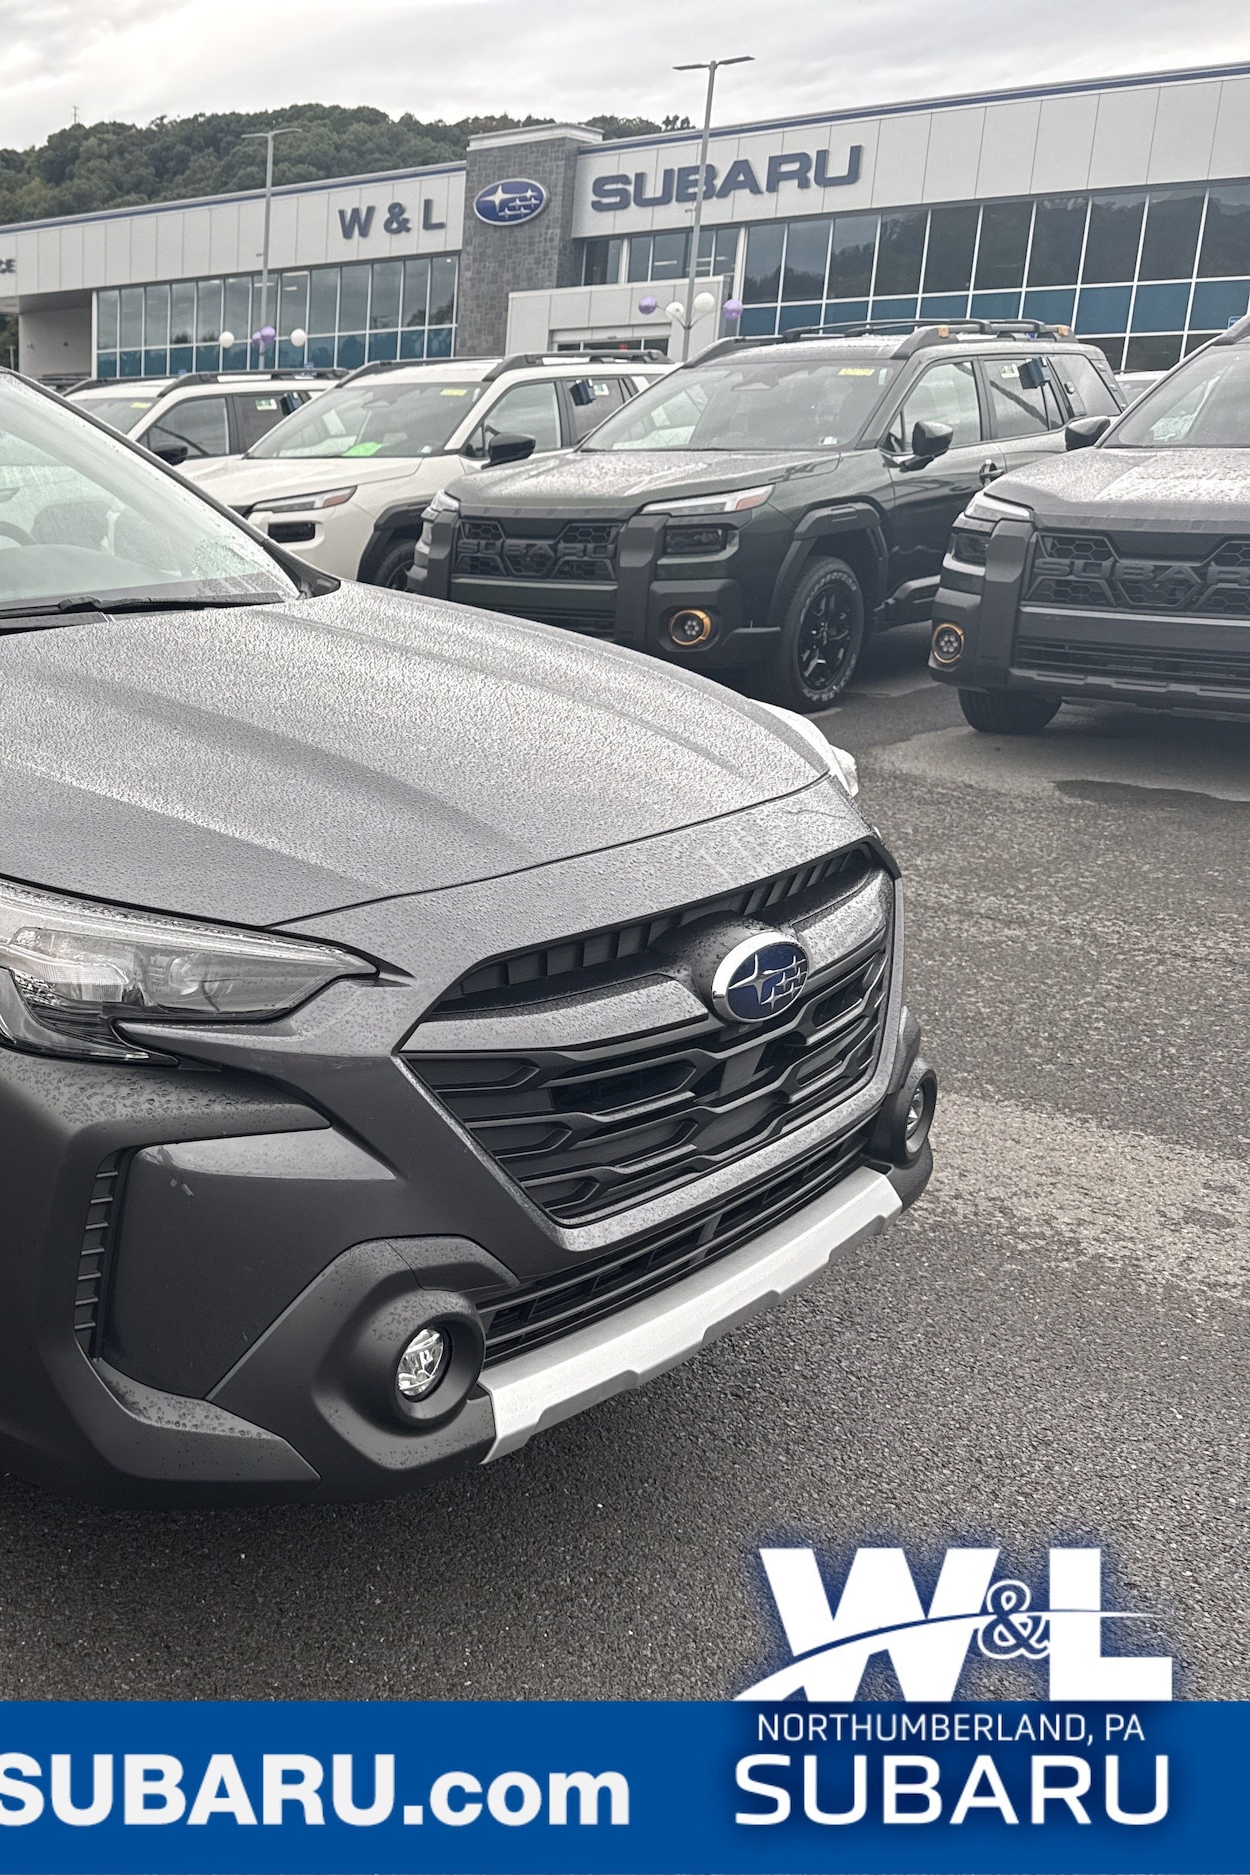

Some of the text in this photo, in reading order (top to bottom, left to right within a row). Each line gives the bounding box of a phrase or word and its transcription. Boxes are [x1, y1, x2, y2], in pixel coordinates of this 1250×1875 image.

[591, 145, 862, 212] SUBARU
[338, 198, 446, 240] W & L
[457, 538, 616, 560] SUBARU
